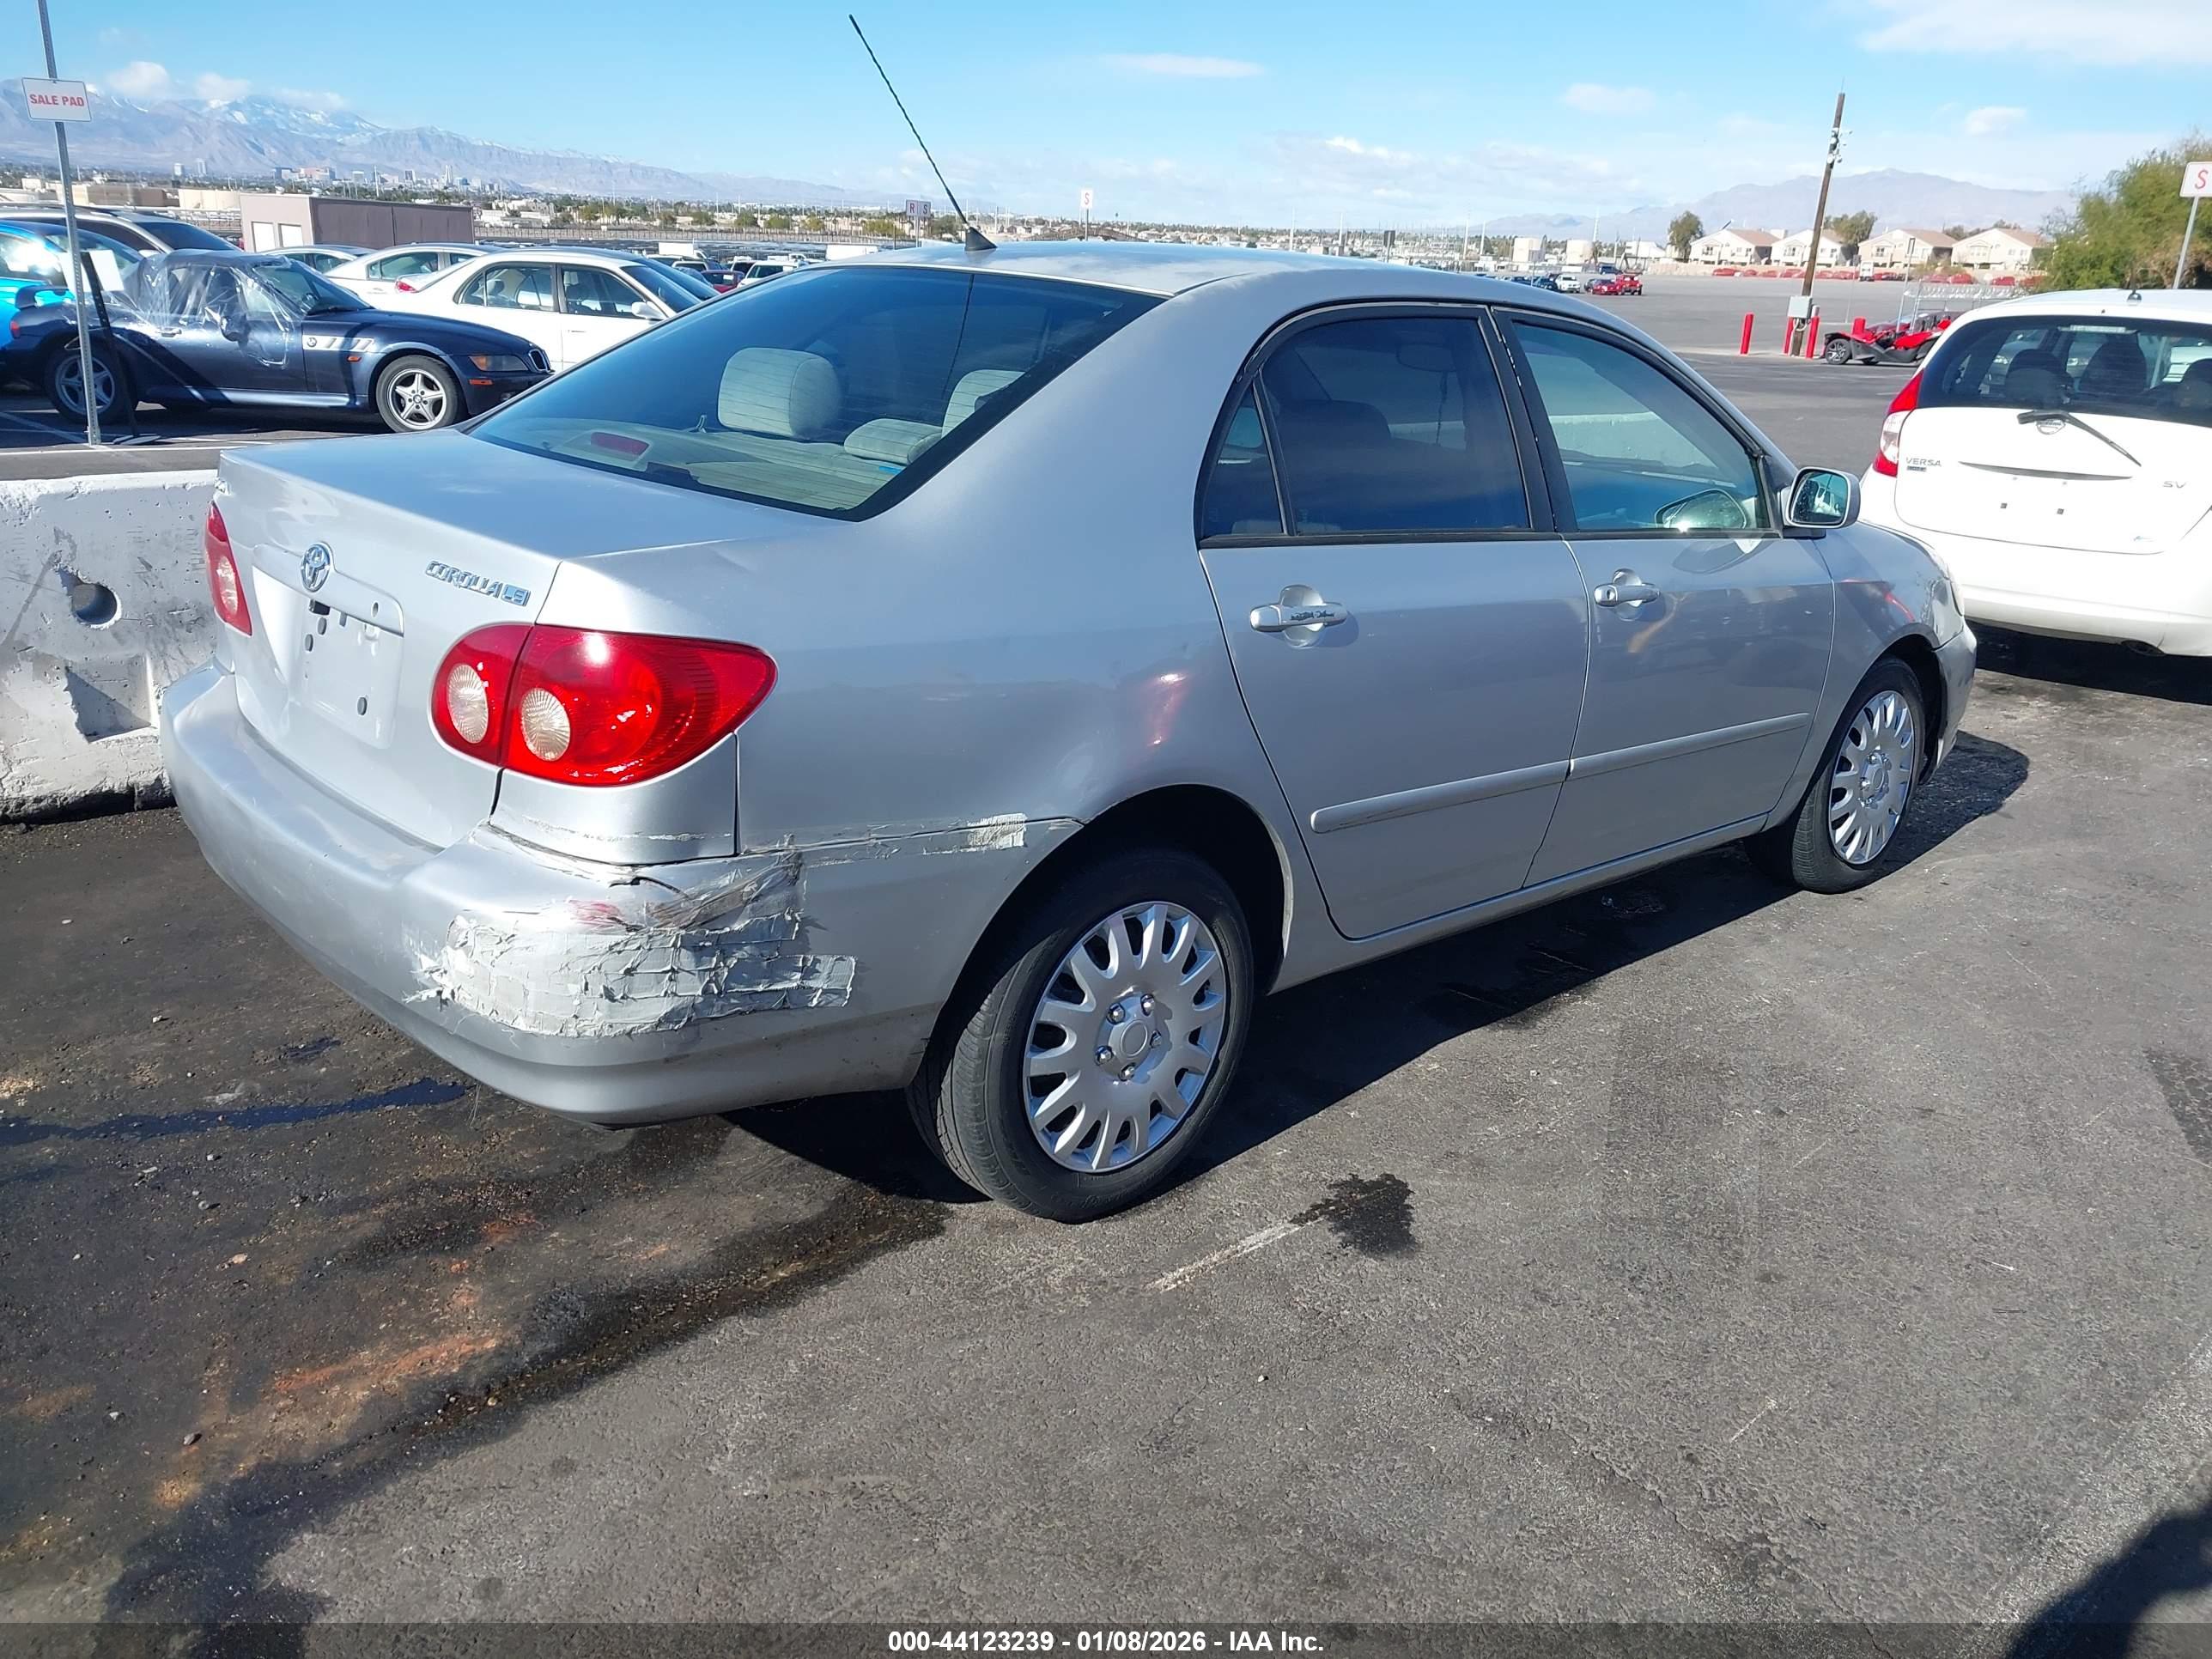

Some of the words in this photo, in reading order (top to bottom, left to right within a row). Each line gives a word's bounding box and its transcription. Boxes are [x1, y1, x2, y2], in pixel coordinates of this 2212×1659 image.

[29, 94, 59, 105] SALE
[61, 96, 84, 106] PAD
[2194, 168, 2209, 189] S
[1084, 191, 1091, 205] S
[909, 203, 915, 214] R
[922, 204, 928, 215] S
[1905, 456, 1942, 467] VERSA
[2162, 480, 2188, 489] SV
[425, 560, 503, 599] COROLLA
[502, 585, 529, 605] LE
